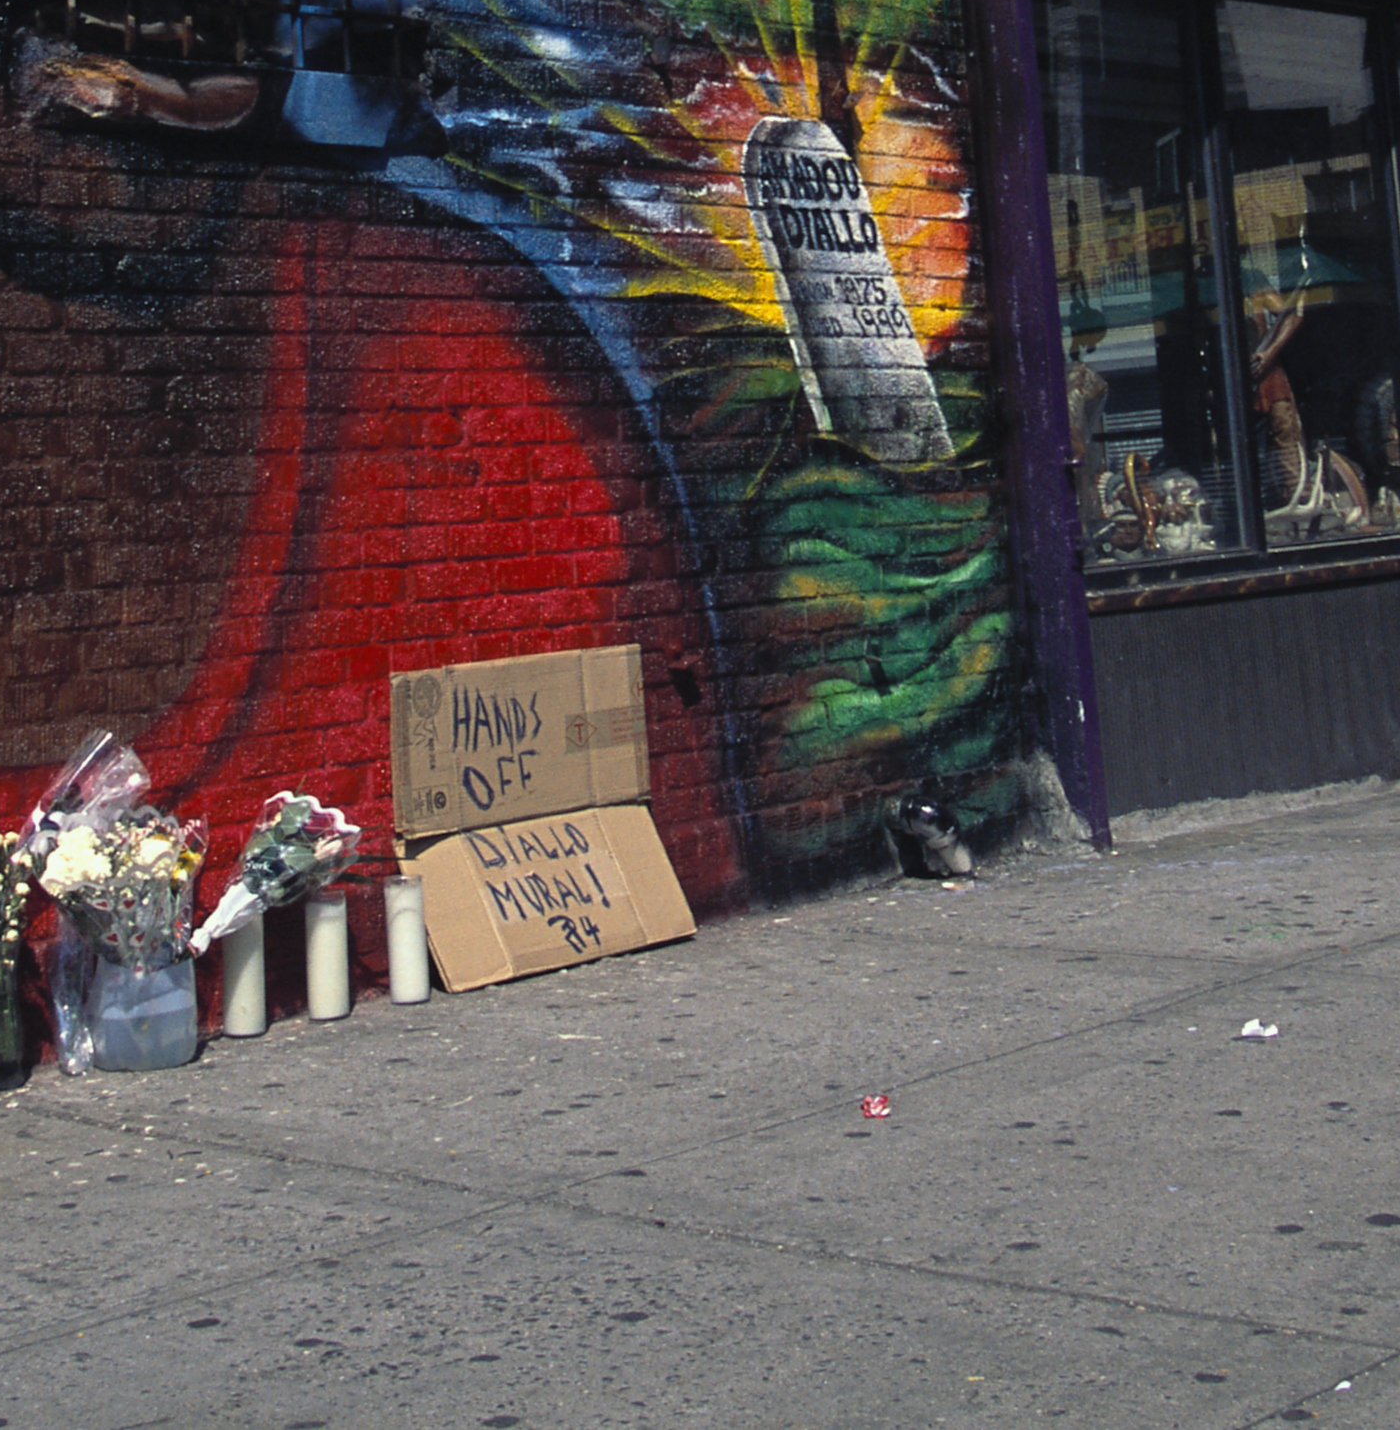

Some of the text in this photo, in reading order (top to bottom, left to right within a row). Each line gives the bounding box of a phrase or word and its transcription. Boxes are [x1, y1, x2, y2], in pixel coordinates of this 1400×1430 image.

[778, 204, 879, 254] DIALLO
[835, 276, 887, 306] 1975
[852, 304, 915, 339] 1999
[452, 683, 543, 755] HANDS
[461, 749, 540, 811] OFF
[464, 820, 591, 870] DIALLO
[485, 862, 611, 922] MURAL!
